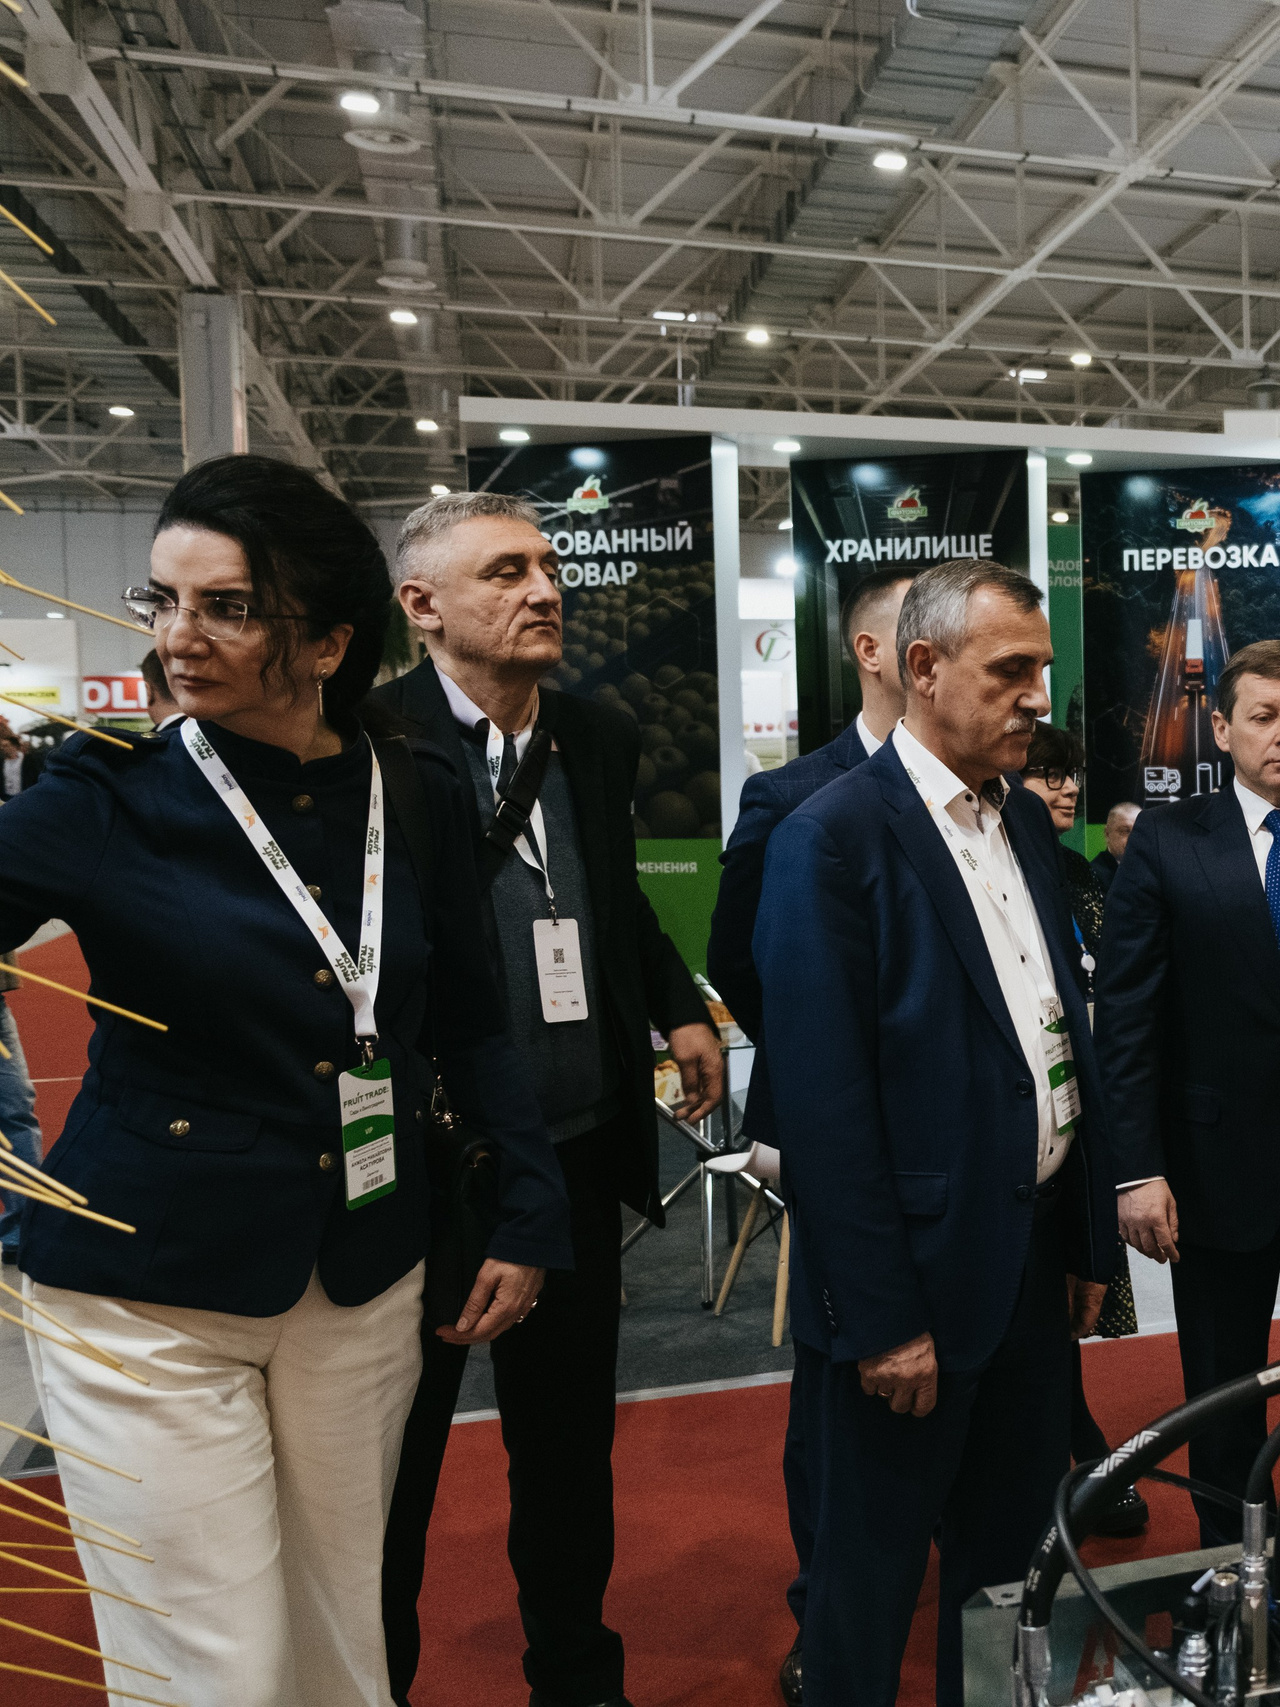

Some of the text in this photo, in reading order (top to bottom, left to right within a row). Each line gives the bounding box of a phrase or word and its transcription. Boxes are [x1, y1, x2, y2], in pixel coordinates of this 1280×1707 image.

[825, 534, 993, 563] ХРАНИЛИЩЕ
[1123, 544, 1279, 571] ПЕРЕВОЗКА
[268, 840, 289, 870] TRADE
[340, 951, 359, 983] TRADE
[365, 1126, 374, 1135] VIP
